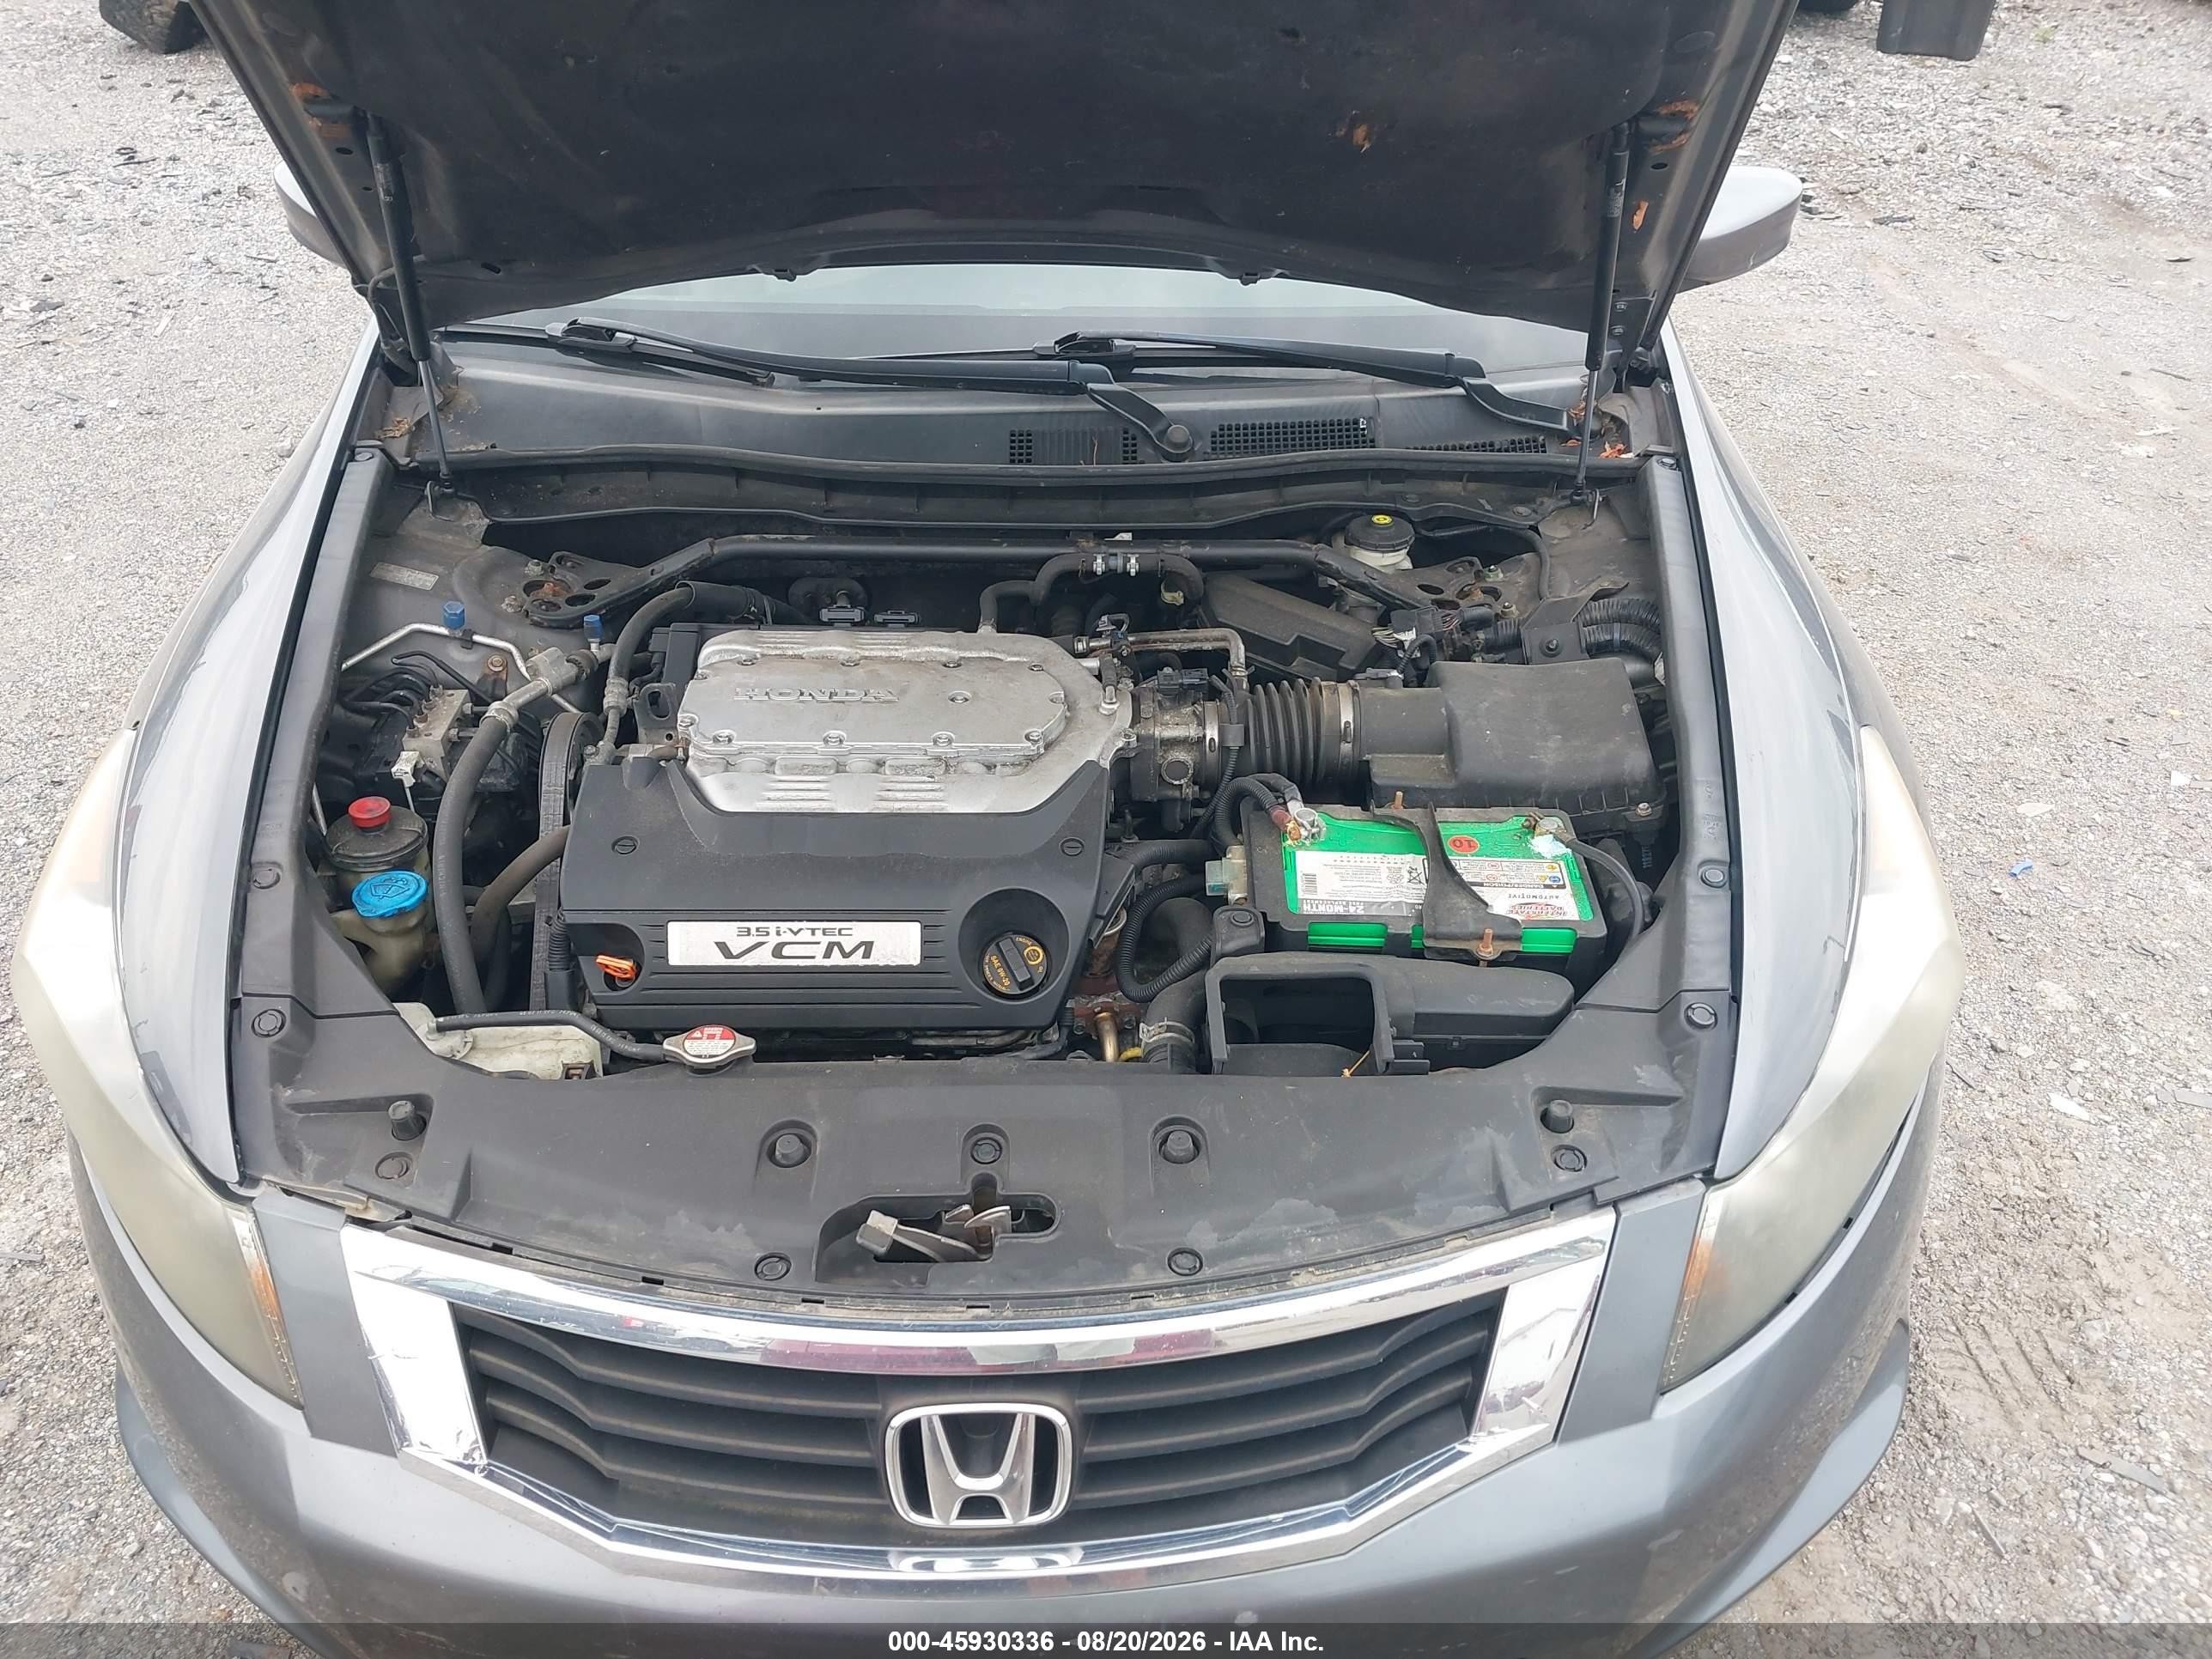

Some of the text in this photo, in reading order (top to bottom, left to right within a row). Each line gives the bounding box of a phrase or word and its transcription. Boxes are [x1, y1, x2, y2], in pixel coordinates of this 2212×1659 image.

[733, 687, 899, 703] HONDA
[736, 927, 769, 937] 3.5
[714, 940, 875, 960] VCM
